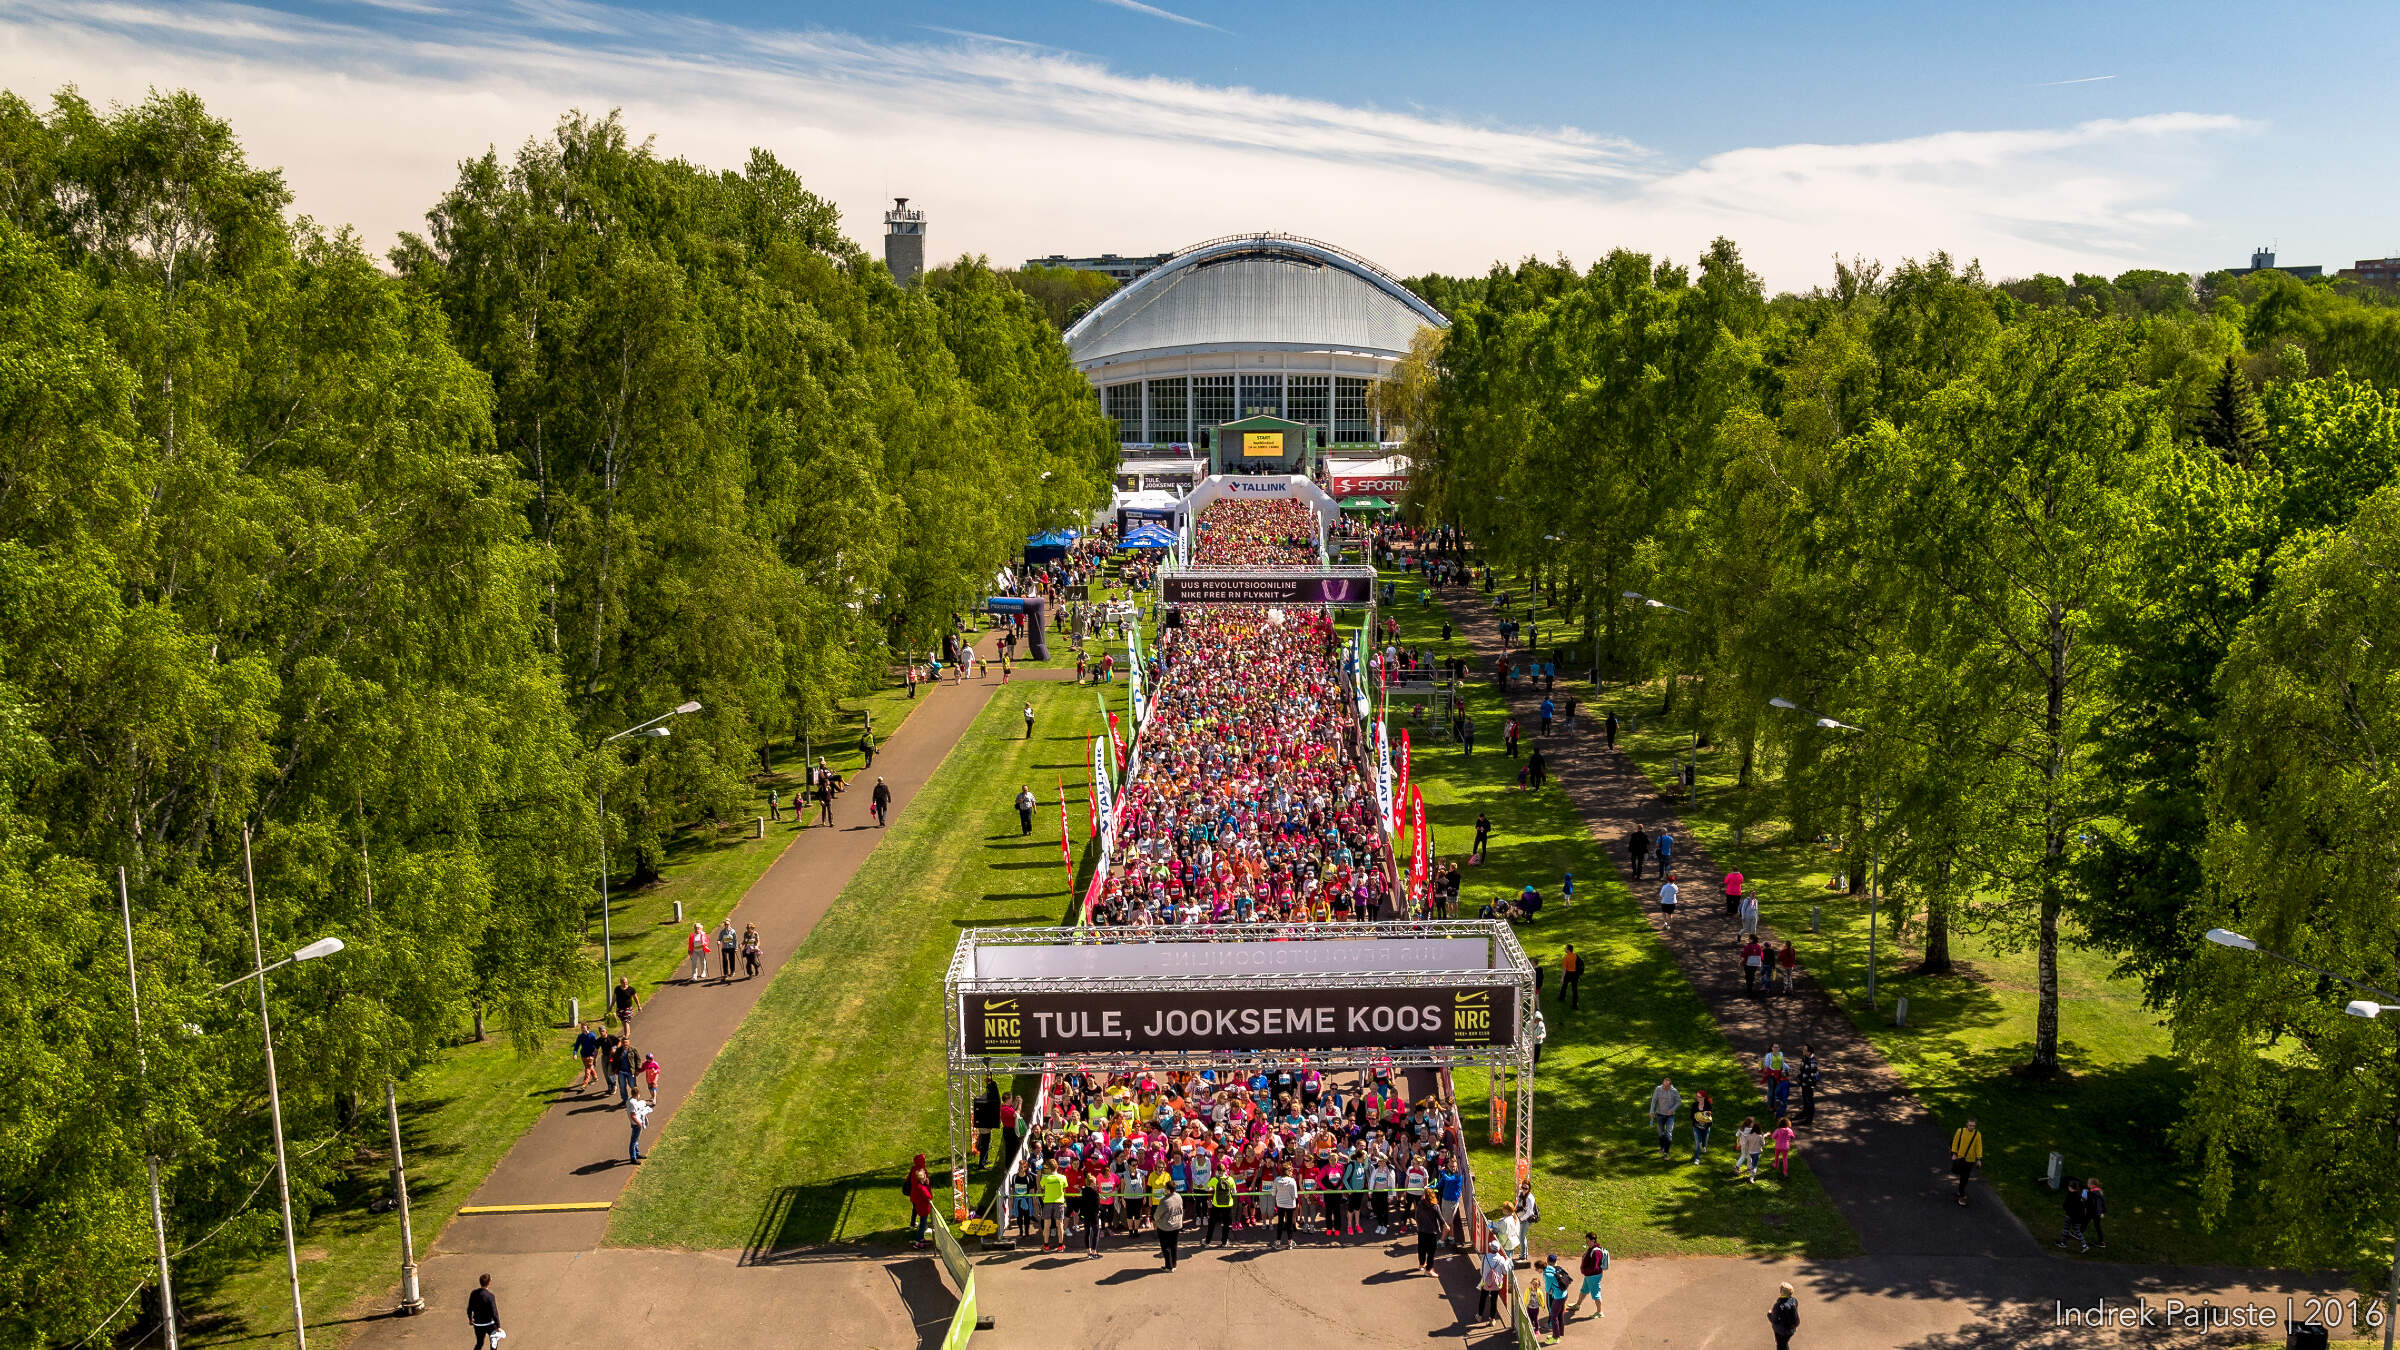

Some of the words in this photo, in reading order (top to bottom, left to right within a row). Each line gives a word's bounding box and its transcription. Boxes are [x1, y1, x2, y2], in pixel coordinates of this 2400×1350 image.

[1242, 483, 1286, 491] TALLINK
[1098, 748, 1109, 818] TALLINK
[984, 1018, 1020, 1038] NRC
[1033, 1011, 1132, 1040] TULE,
[1144, 1008, 1335, 1036] JOOKSEME
[1348, 1006, 1442, 1032] KOOS
[1454, 1010, 1490, 1029] NRC
